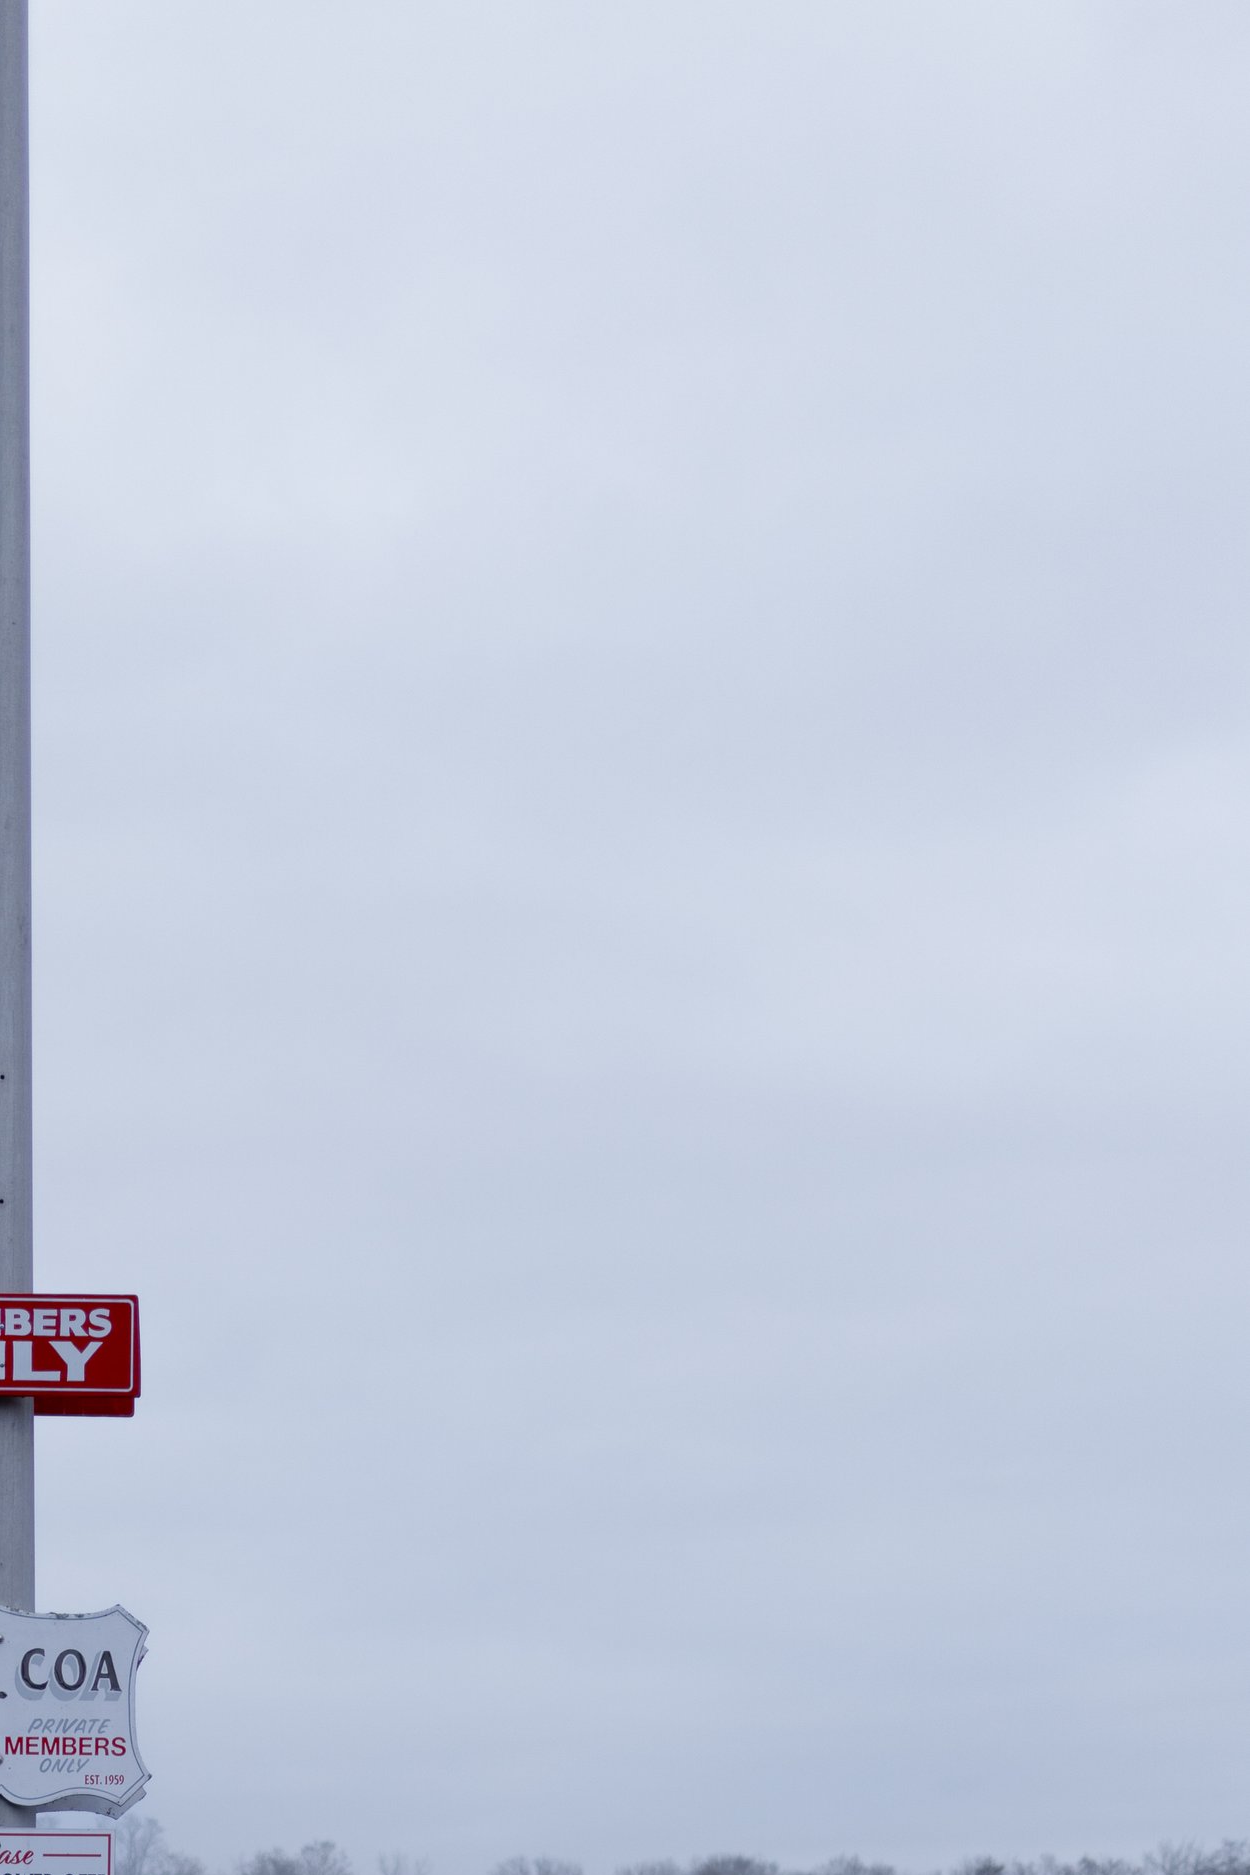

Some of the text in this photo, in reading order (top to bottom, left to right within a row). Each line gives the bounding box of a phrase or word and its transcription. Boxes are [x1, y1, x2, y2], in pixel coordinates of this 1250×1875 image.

[17, 1648, 122, 1696] COA
[28, 1718, 111, 1734] PRIVATE
[4, 1736, 127, 1756] MEMBERS
[39, 1758, 90, 1774] ONLY
[84, 1774, 125, 1786] EST. 1959
